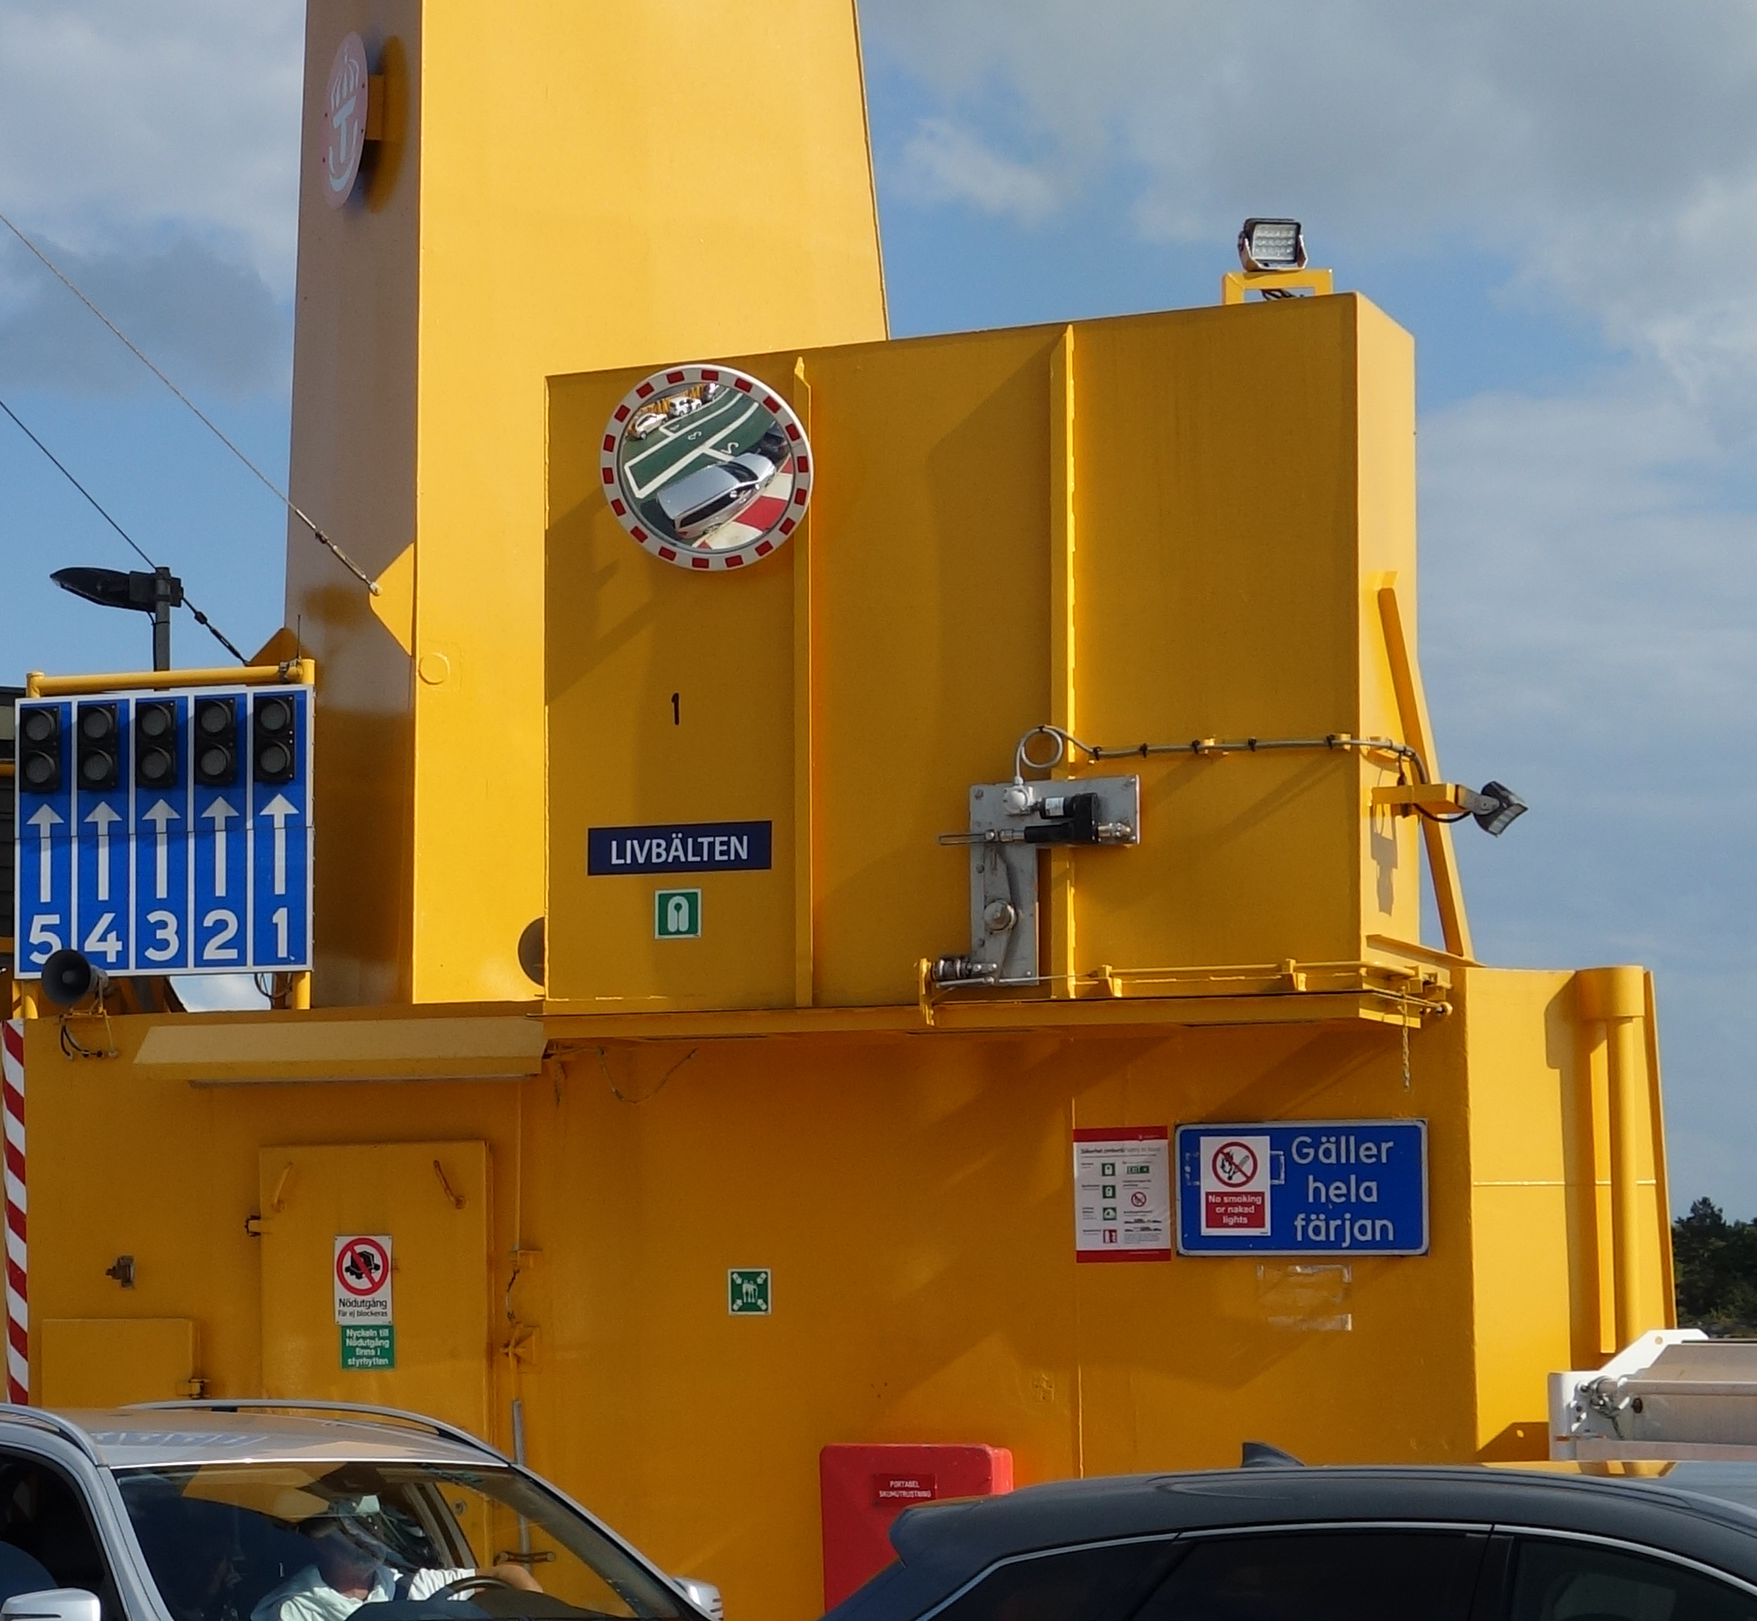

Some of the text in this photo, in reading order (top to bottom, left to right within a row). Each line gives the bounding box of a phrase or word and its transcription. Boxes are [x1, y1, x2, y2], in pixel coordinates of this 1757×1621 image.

[610, 832, 748, 865] LIVBÄLTEN
[28, 907, 289, 965] 5 4 3 2 1
[1291, 1135, 1394, 1164] Gäller
[1307, 1174, 1378, 1203] hela
[1208, 1194, 1262, 1205] No smoking
[1215, 1205, 1255, 1214] or naked
[1222, 1215, 1248, 1226] lights
[1293, 1212, 1394, 1248] färjan
[338, 1297, 388, 1310] Nödutgång
[356, 1309, 388, 1317] blockeras
